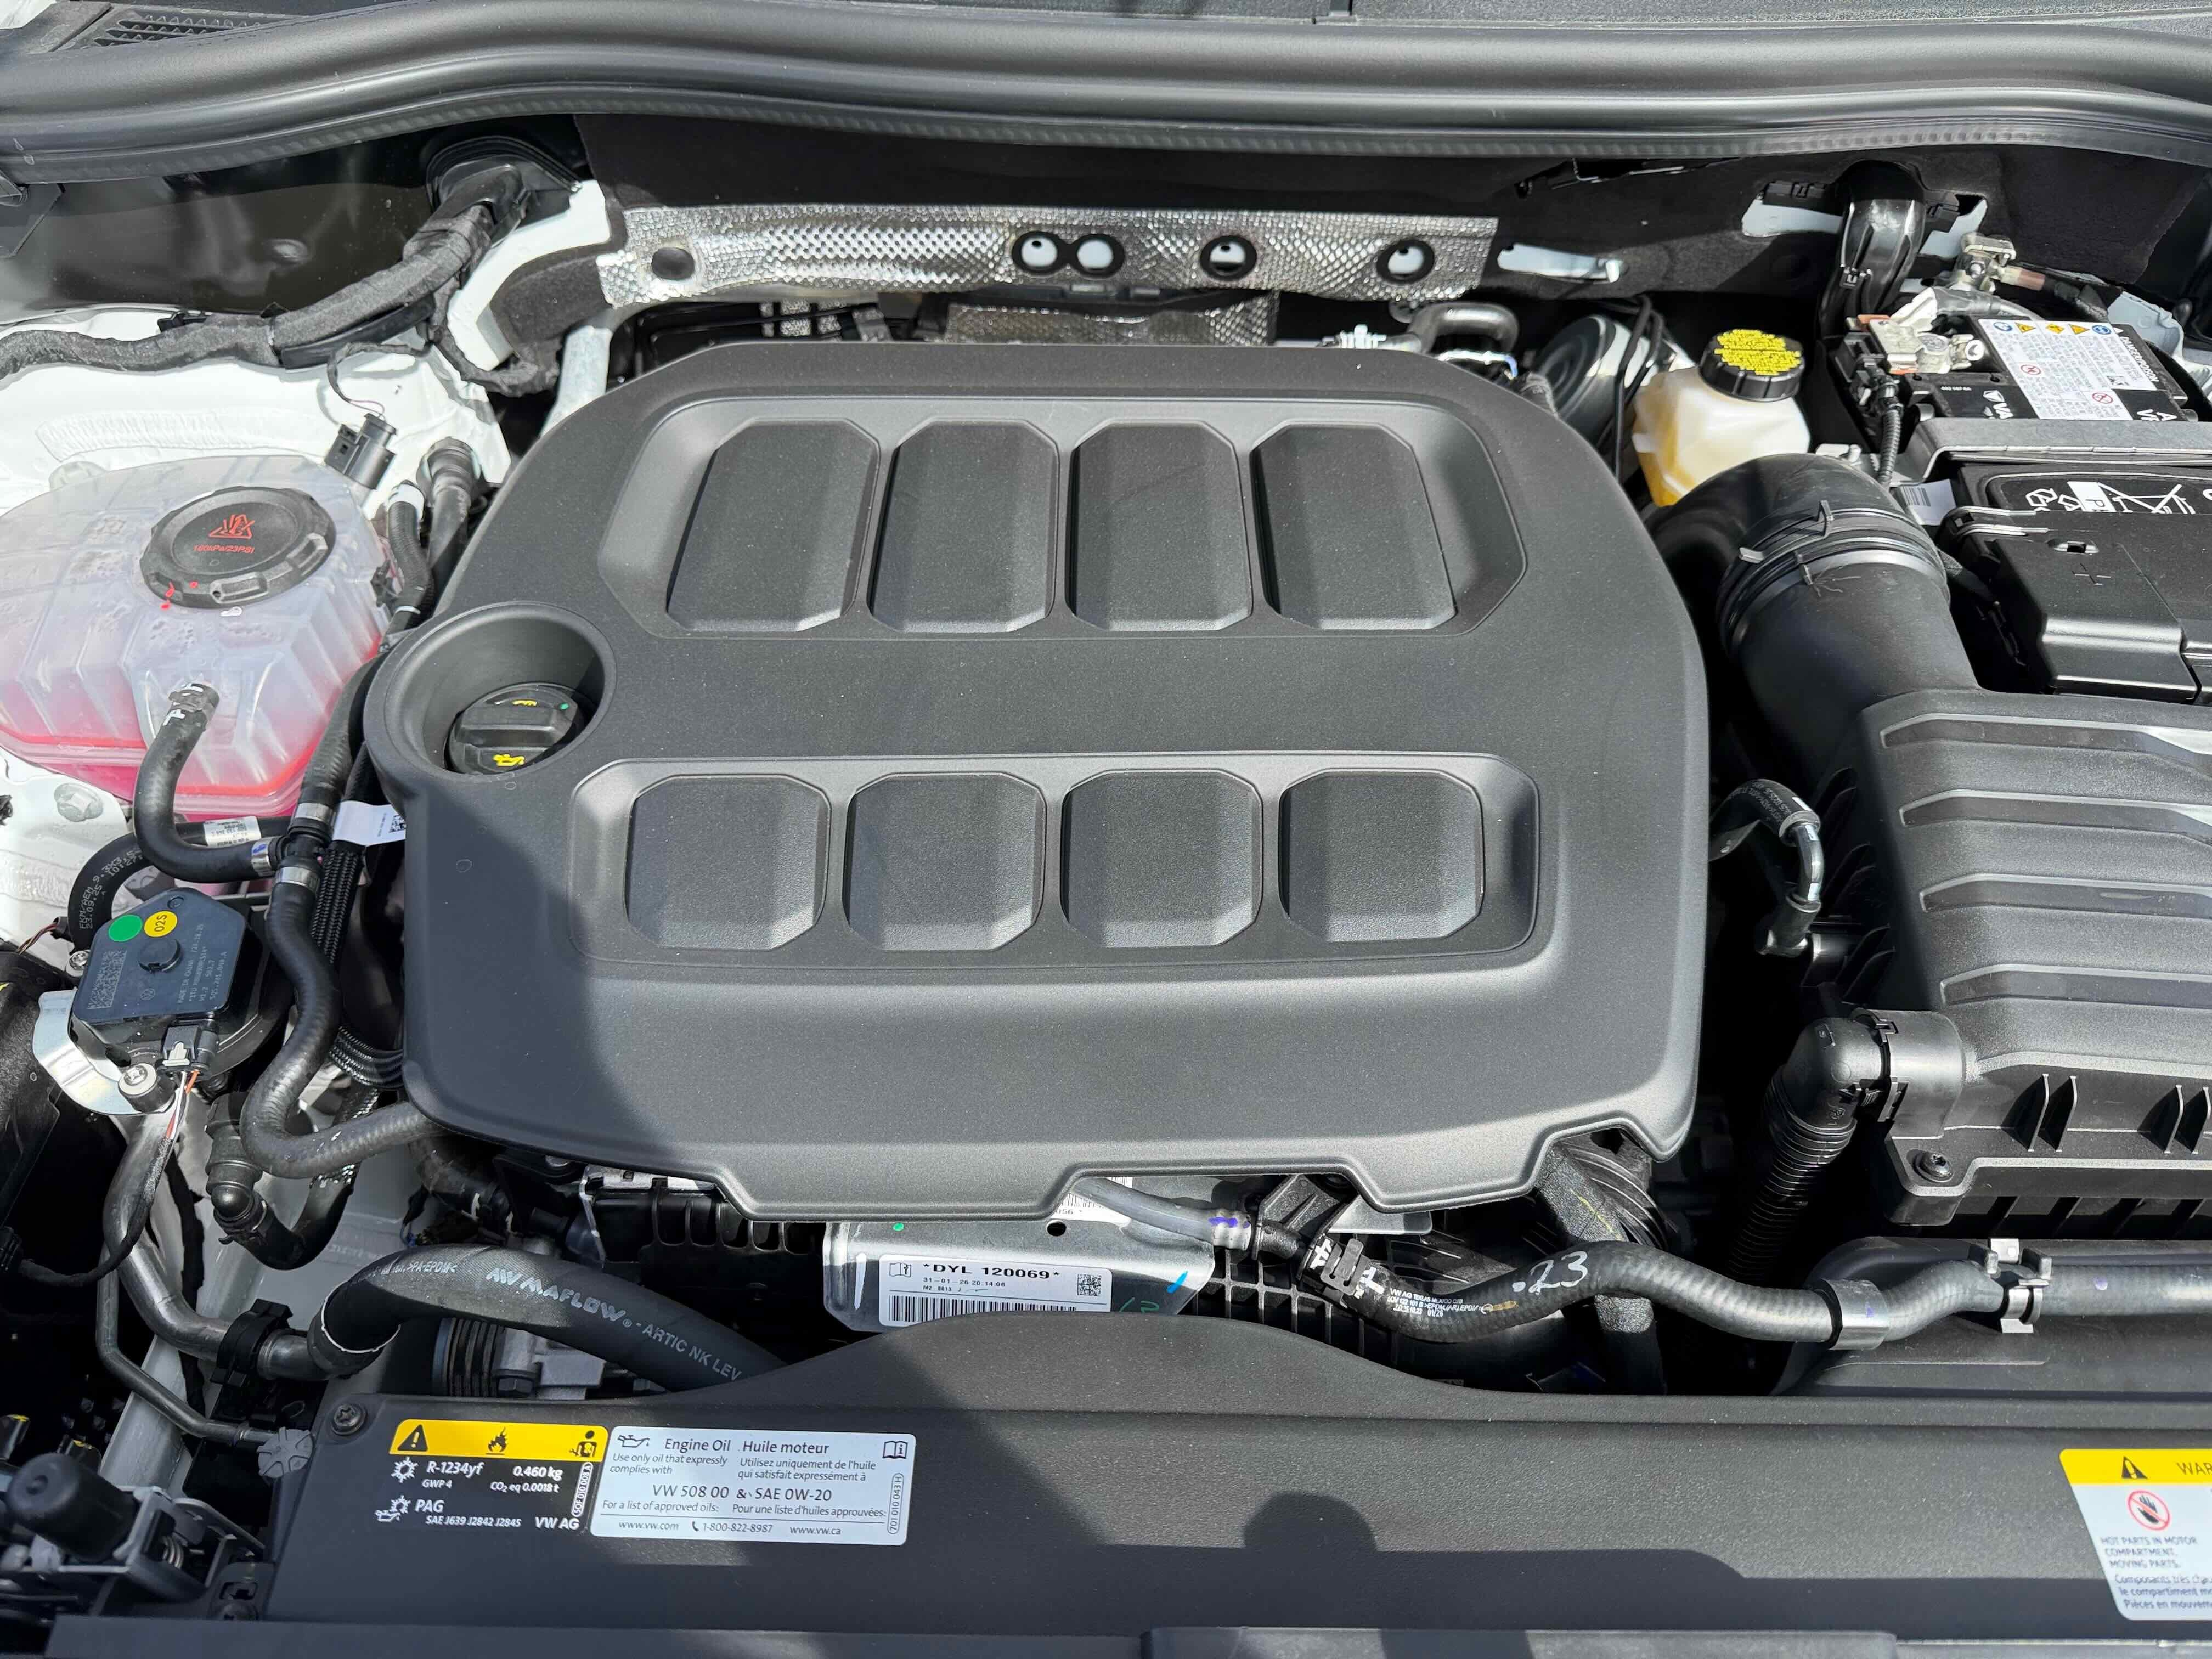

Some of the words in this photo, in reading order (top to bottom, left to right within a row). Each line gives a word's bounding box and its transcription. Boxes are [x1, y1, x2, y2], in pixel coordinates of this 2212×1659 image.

[642, 1323, 689, 1353] ARTIC
[688, 1346, 713, 1366] NK
[665, 1438, 709, 1453] Engine
[712, 1439, 731, 1452] Oil
[742, 1440, 778, 1453] Huile
[780, 1442, 830, 1454] moteur
[631, 1454, 651, 1464] only
[665, 1455, 685, 1464] that
[685, 1456, 729, 1466] expressly
[740, 1457, 774, 1468] Utilisez
[776, 1459, 833, 1472] uniquement
[834, 1460, 847, 1470] de
[848, 1460, 877, 1470] l'huile
[426, 1460, 484, 1479] R-1234yf
[513, 1465, 548, 1477] 0.460
[548, 1466, 563, 1482] kg
[610, 1465, 650, 1476] complies
[652, 1465, 673, 1475] with
[737, 1470, 753, 1481] qui
[754, 1470, 792, 1480] satisfait
[793, 1471, 859, 1483] expressément
[860, 1472, 866, 1481] à
[422, 1479, 445, 1488] GWP
[445, 1480, 453, 1489] 4
[508, 1482, 521, 1494] eq
[522, 1482, 553, 1493] 0.0018
[553, 1483, 560, 1493] t
[652, 1484, 678, 1497] VW
[680, 1486, 707, 1498] 508
[710, 1486, 730, 1498] 00
[736, 1488, 747, 1499] &
[754, 1487, 782, 1500] SAE
[785, 1488, 833, 1502] 0W-20
[415, 1498, 445, 1513] PAG
[602, 1499, 617, 1509] For
[627, 1500, 641, 1510] list
[643, 1501, 654, 1510] of
[654, 1502, 699, 1514] approved
[699, 1503, 720, 1513] oils:
[732, 1504, 754, 1514] Pour
[755, 1505, 773, 1514] une
[774, 1505, 794, 1515] liste
[794, 1505, 830, 1516] d'huiles
[831, 1507, 887, 1519] approuvées:
[426, 1515, 443, 1525] SAE
[444, 1516, 466, 1526] J639
[467, 1516, 494, 1527] J2842
[494, 1517, 522, 1527] J2845
[535, 1516, 558, 1529] VW
[558, 1517, 580, 1530] AG
[618, 1521, 679, 1531] www.vw.com
[703, 1522, 773, 1533] 1-800-822-8987
[789, 1526, 842, 1536] www.vw.ca
[2101, 1536, 2119, 1545] HOT
[2121, 1536, 2151, 1545] PARTS
[2152, 1536, 2163, 1545] IN
[2164, 1536, 2198, 1545] MOTOR
[2109, 1560, 2148, 1569] MOVING
[2118, 1586, 2129, 1596] le
[2131, 1587, 2199, 1598] compartiment
[2124, 1599, 2154, 1609] Pièces
